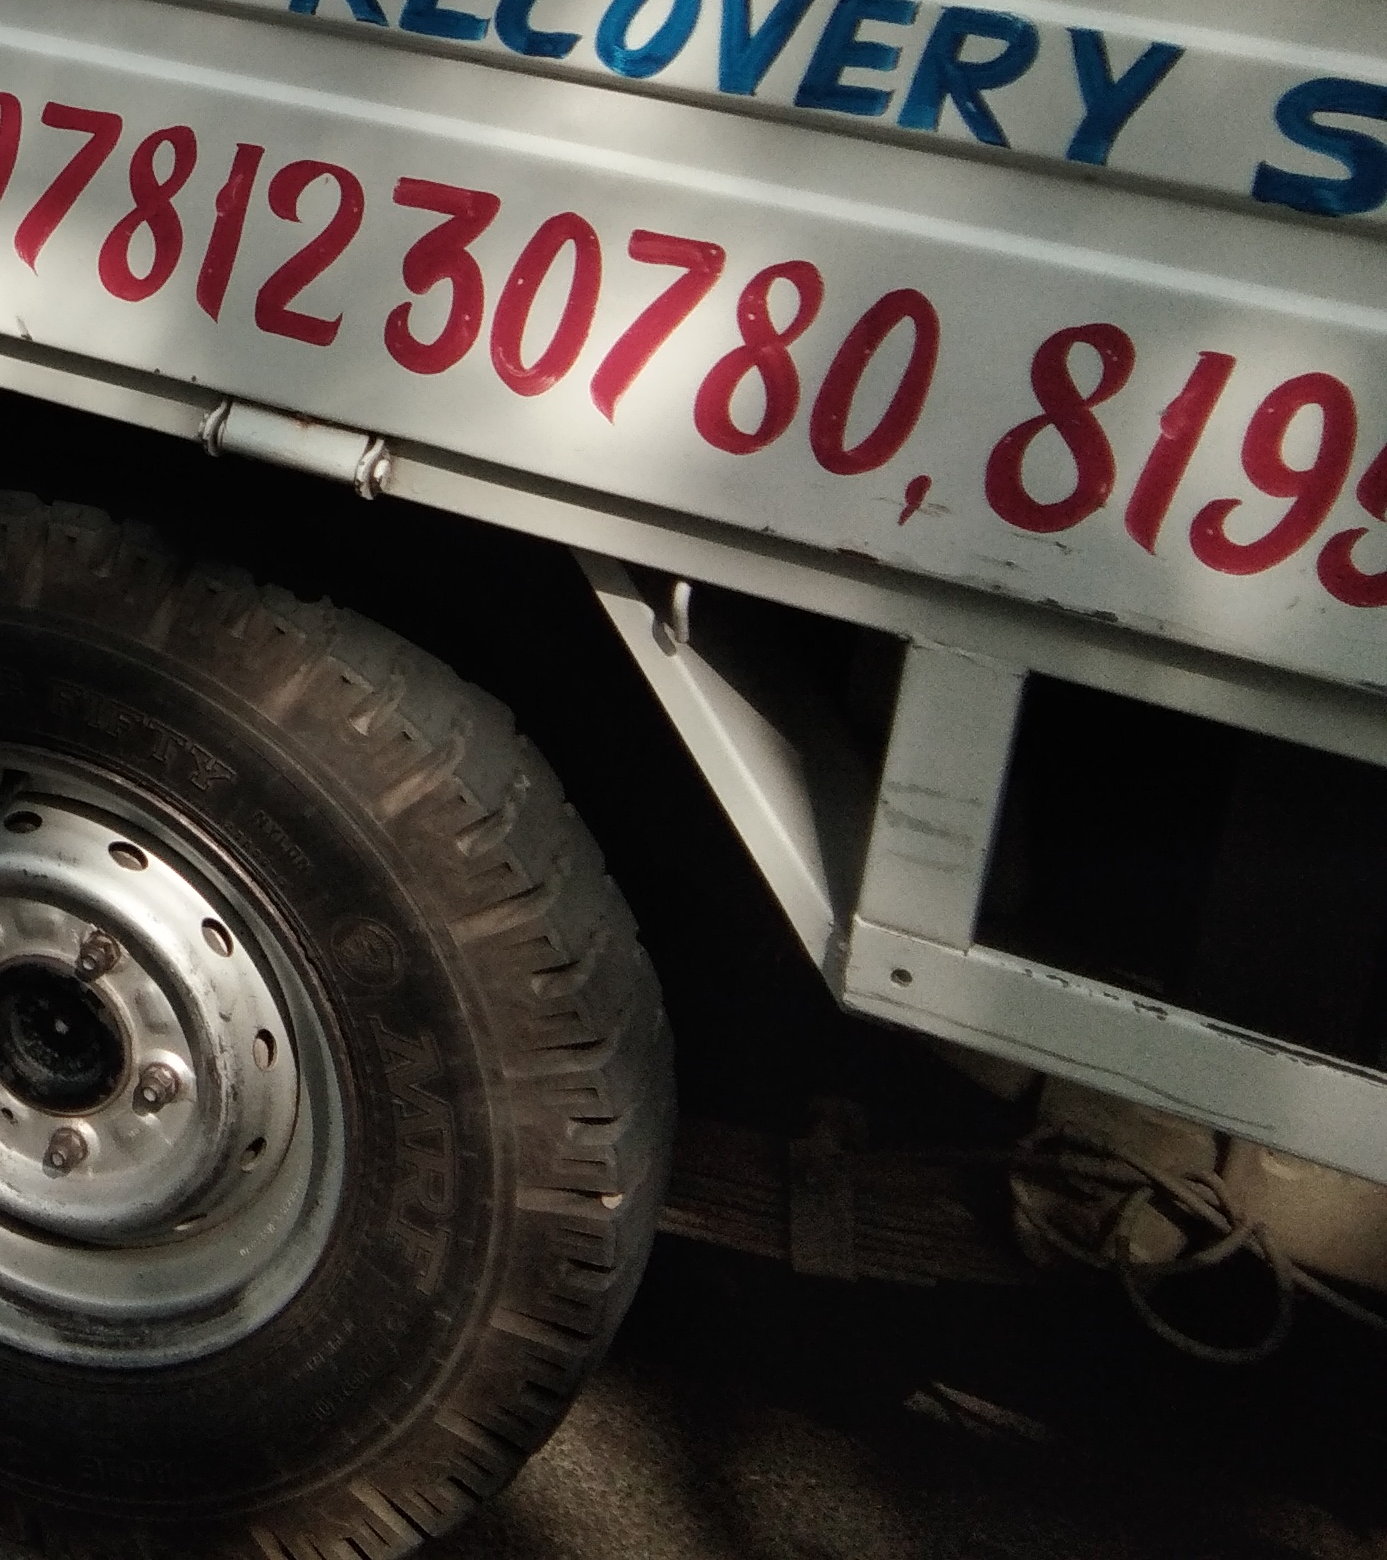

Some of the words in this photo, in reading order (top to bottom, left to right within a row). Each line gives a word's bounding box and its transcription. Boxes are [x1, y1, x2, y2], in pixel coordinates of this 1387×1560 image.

[1252, 77, 1387, 217] S
[45, 677, 238, 792] FIFTY
[366, 1012, 459, 1296] MRF
